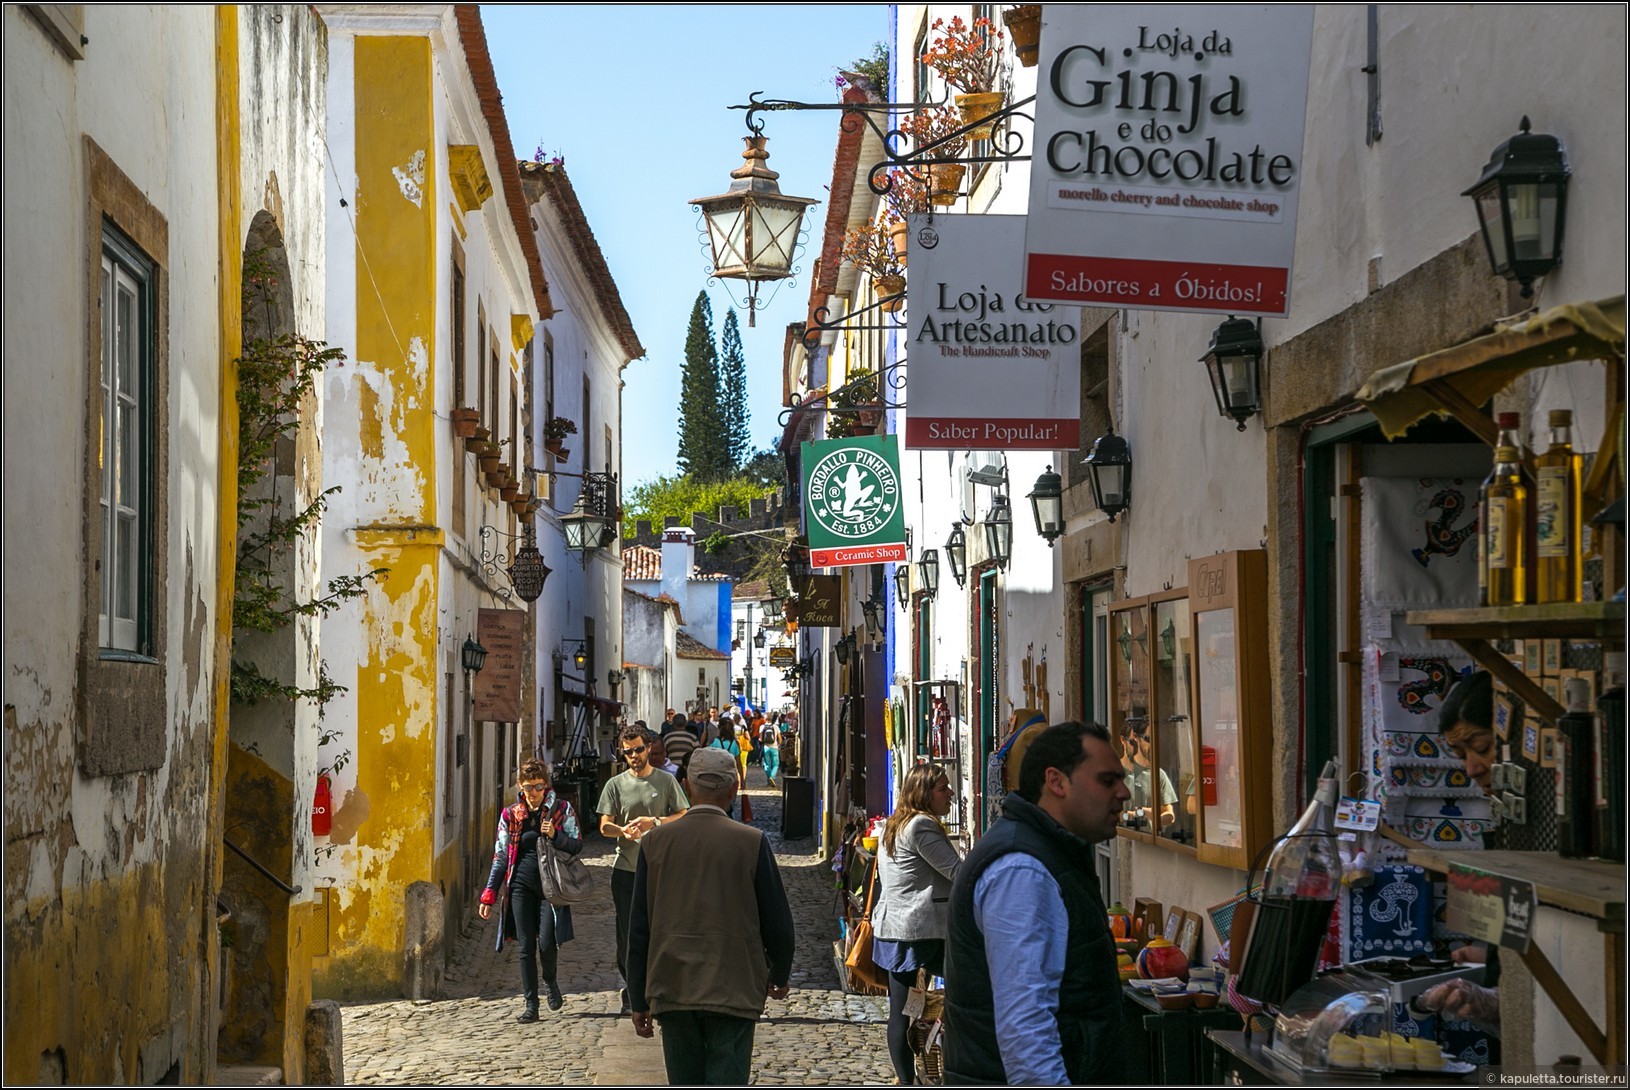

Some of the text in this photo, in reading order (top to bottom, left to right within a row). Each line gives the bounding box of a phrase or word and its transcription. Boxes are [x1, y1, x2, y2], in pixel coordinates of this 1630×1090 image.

[1137, 26, 1232, 57] Loja da
[1050, 44, 1244, 134] Ginja
[1117, 118, 1172, 142] e do
[1046, 129, 1293, 186] Chocolate
[1058, 187, 1280, 217] morello cherry and chocolate shop
[936, 282, 1004, 321] Loja
[1050, 270, 1263, 303] Sabores a Óbidos!
[915, 313, 1076, 344] Artesanato
[939, 345, 1051, 361] The Handicraft Shop
[928, 422, 1059, 444] Saber Popular!
[811, 451, 896, 500] BORDALLO PINHEIRO
[831, 516, 883, 535] Est. 1884
[518, 552, 541, 560] CASA
[834, 549, 875, 561] Ceramic
[876, 548, 901, 559] Shop
[803, 611, 834, 623] Roca
